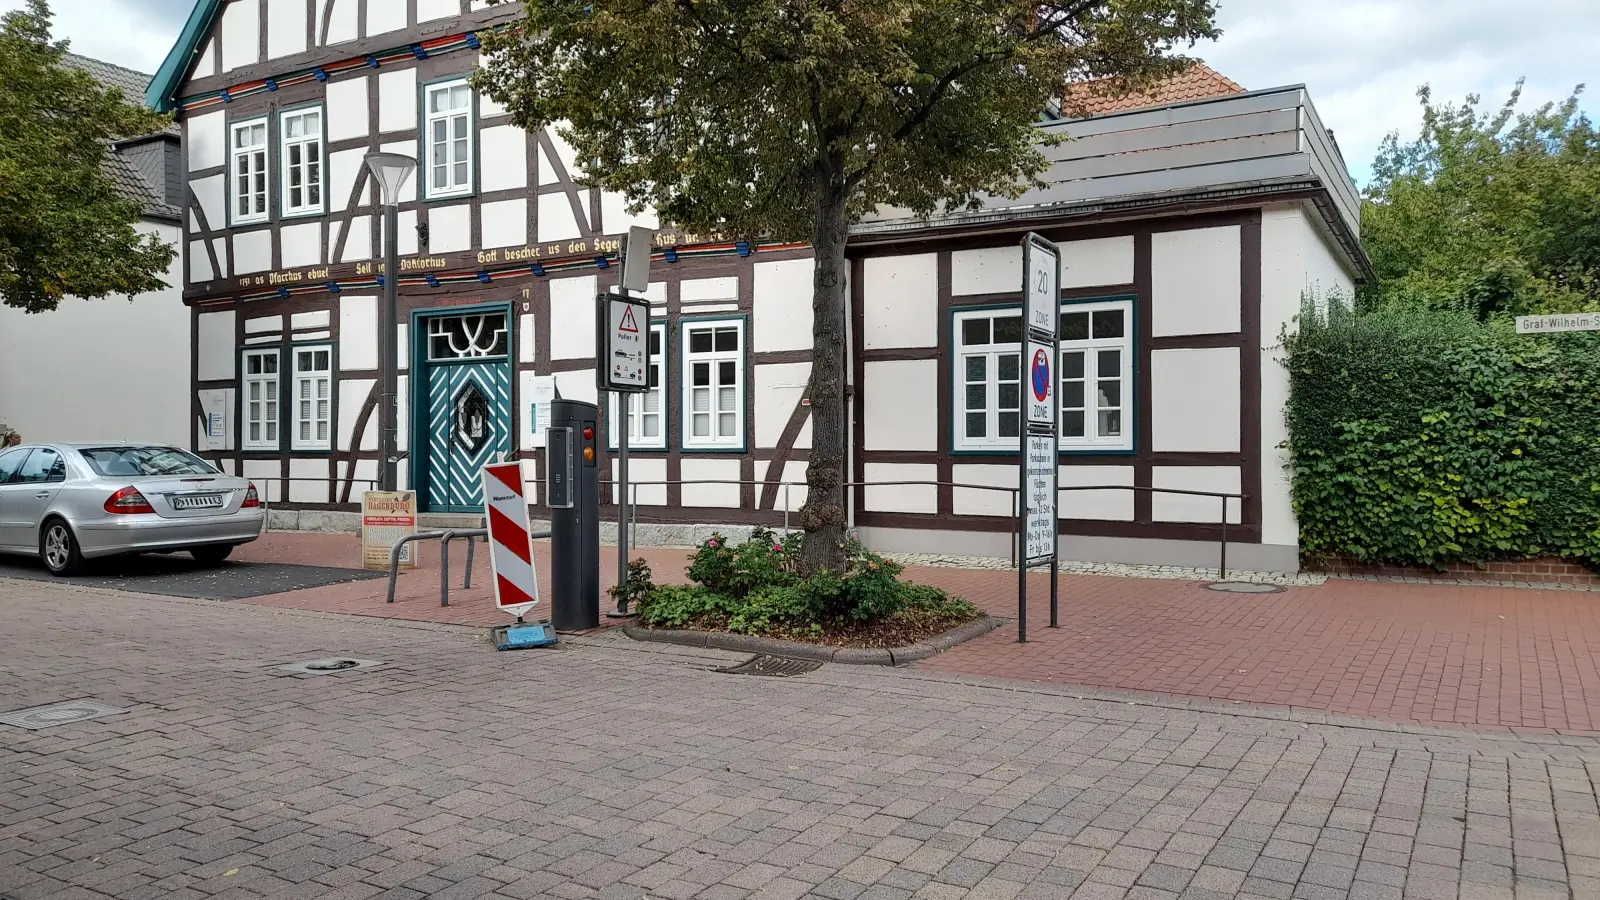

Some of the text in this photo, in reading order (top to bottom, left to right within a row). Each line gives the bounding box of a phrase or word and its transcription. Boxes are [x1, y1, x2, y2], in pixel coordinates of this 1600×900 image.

[477, 249, 498, 264] Gott
[548, 241, 560, 254] us
[568, 240, 586, 254] den
[355, 262, 371, 275] Seit
[1037, 269, 1048, 295] 20
[1035, 310, 1049, 327] ZONE
[618, 332, 632, 341] Poller
[1033, 404, 1048, 419] ZONE
[1029, 544, 1035, 554] Fr
